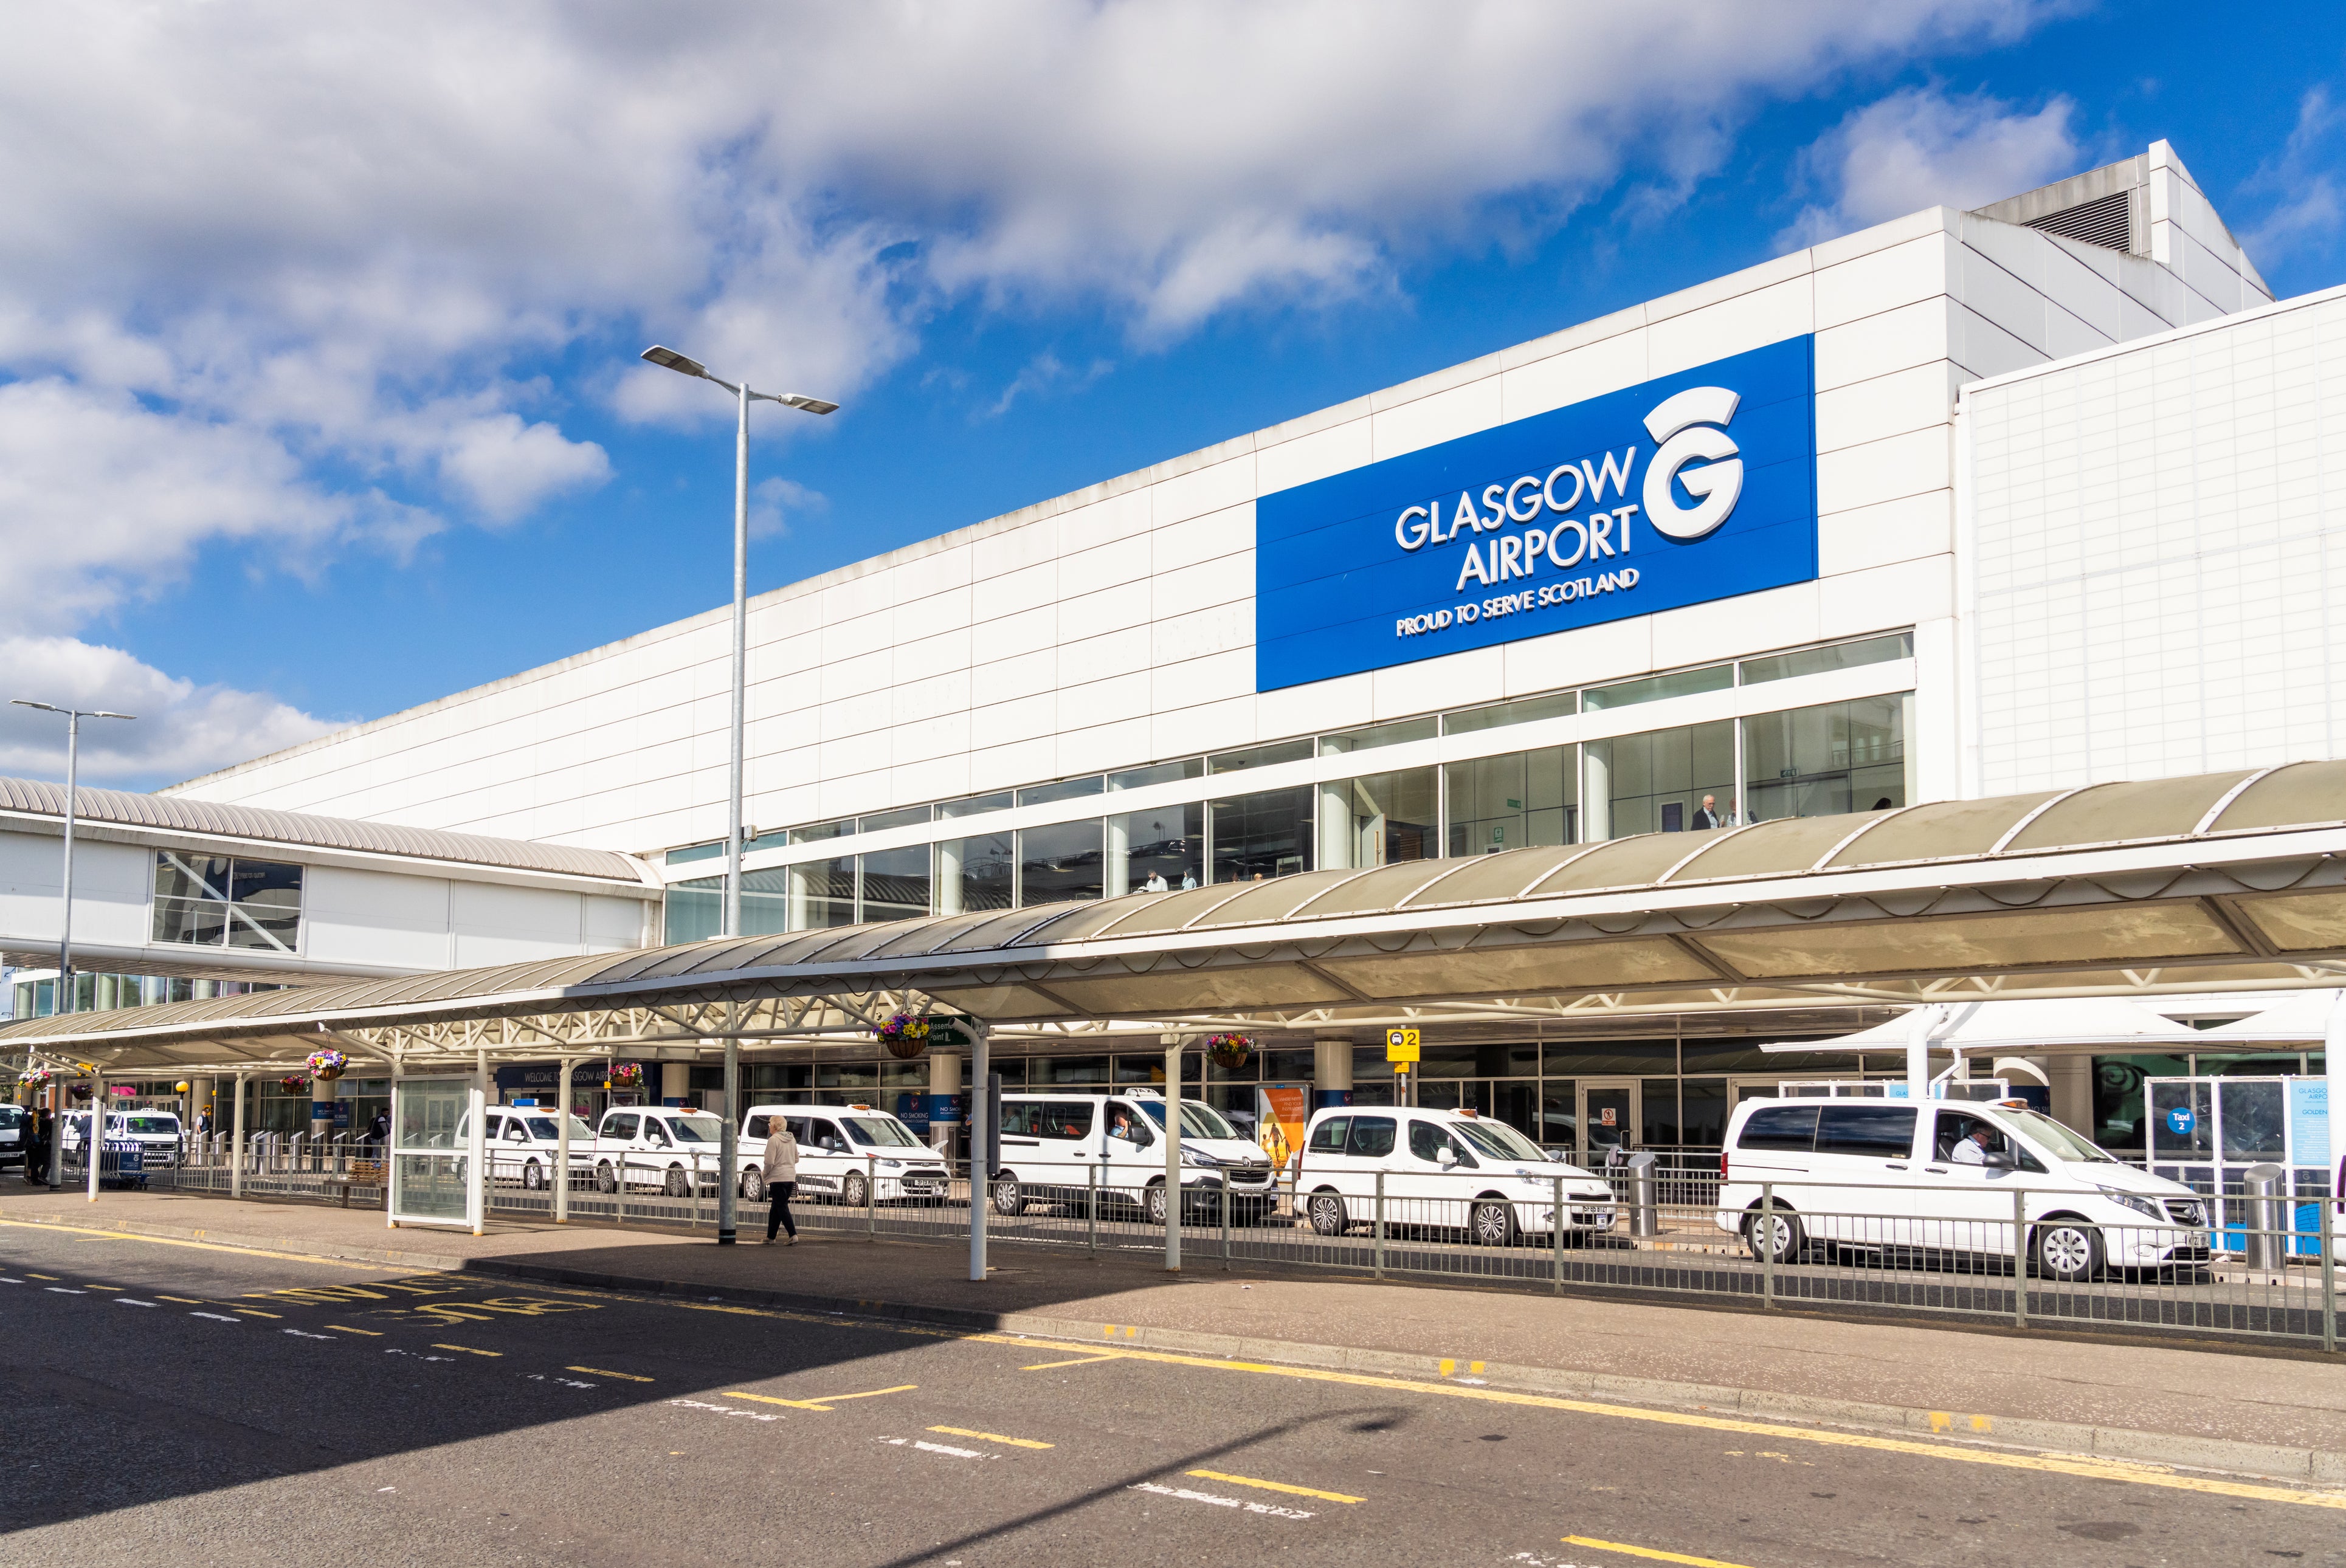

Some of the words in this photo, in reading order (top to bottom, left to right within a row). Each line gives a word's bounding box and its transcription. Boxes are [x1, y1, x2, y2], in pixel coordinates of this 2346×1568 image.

[1395, 445, 1637, 549] GLASGOW
[1643, 427, 1744, 538] G
[1455, 504, 1638, 591] AIRPORT
[1396, 610, 1453, 636] PROUD
[1455, 603, 1480, 624] TO
[1482, 590, 1535, 619] SERVE
[1538, 568, 1640, 604] SCOTLAND
[930, 1033, 944, 1041] oint
[1407, 1032, 1416, 1045] 2
[525, 1072, 552, 1082] WELCOME
[554, 1071, 560, 1081] TO
[571, 1070, 594, 1082] ASGOW
[596, 1070, 609, 1081] AIRP
[2172, 1113, 2190, 1121] Taxi
